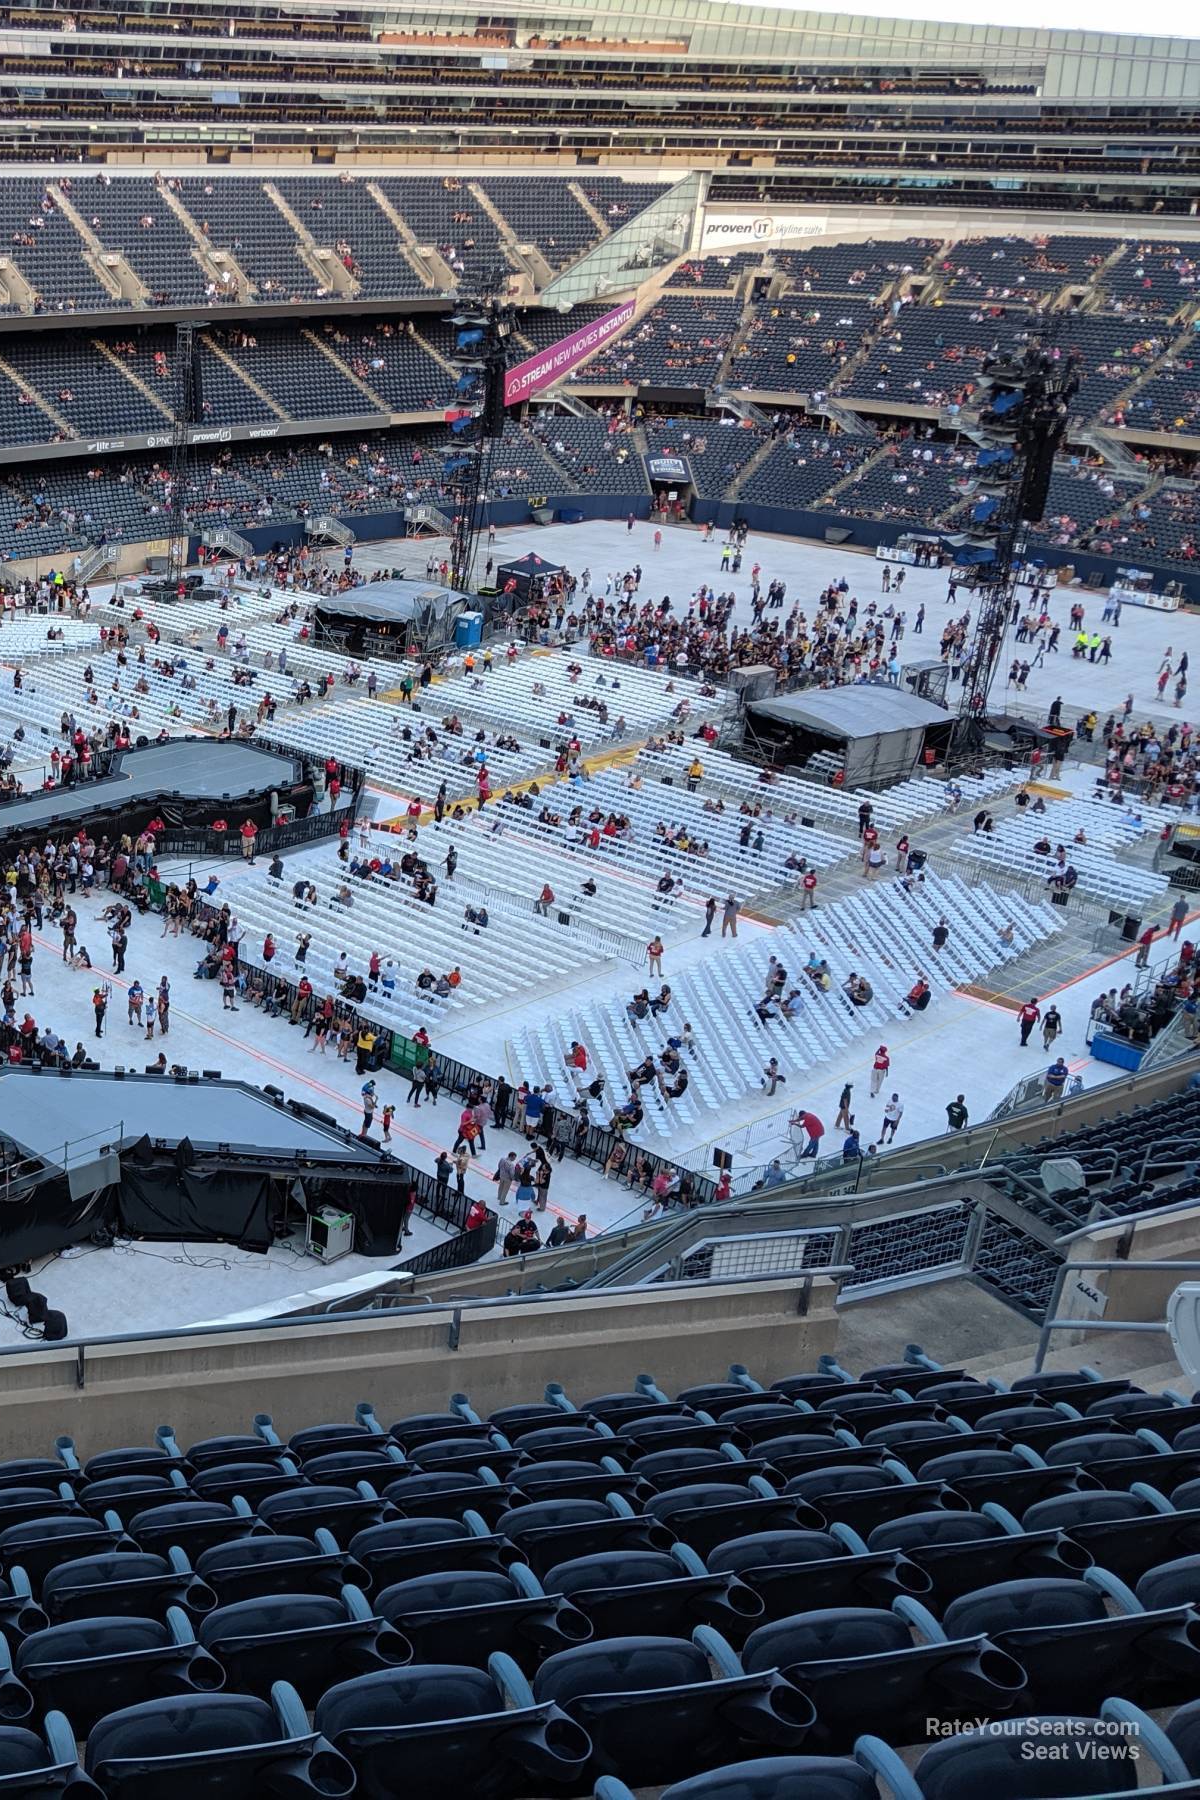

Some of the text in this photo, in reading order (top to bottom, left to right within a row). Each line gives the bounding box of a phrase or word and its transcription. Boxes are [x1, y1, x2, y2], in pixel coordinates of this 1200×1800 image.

[706, 223, 824, 237] proven IT skyline suite
[521, 306, 634, 388] STREAM NEW MOVIES INSTANTLY
[192, 432, 220, 443] proven
[249, 427, 276, 438] verizon
[96, 441, 109, 452] Lite
